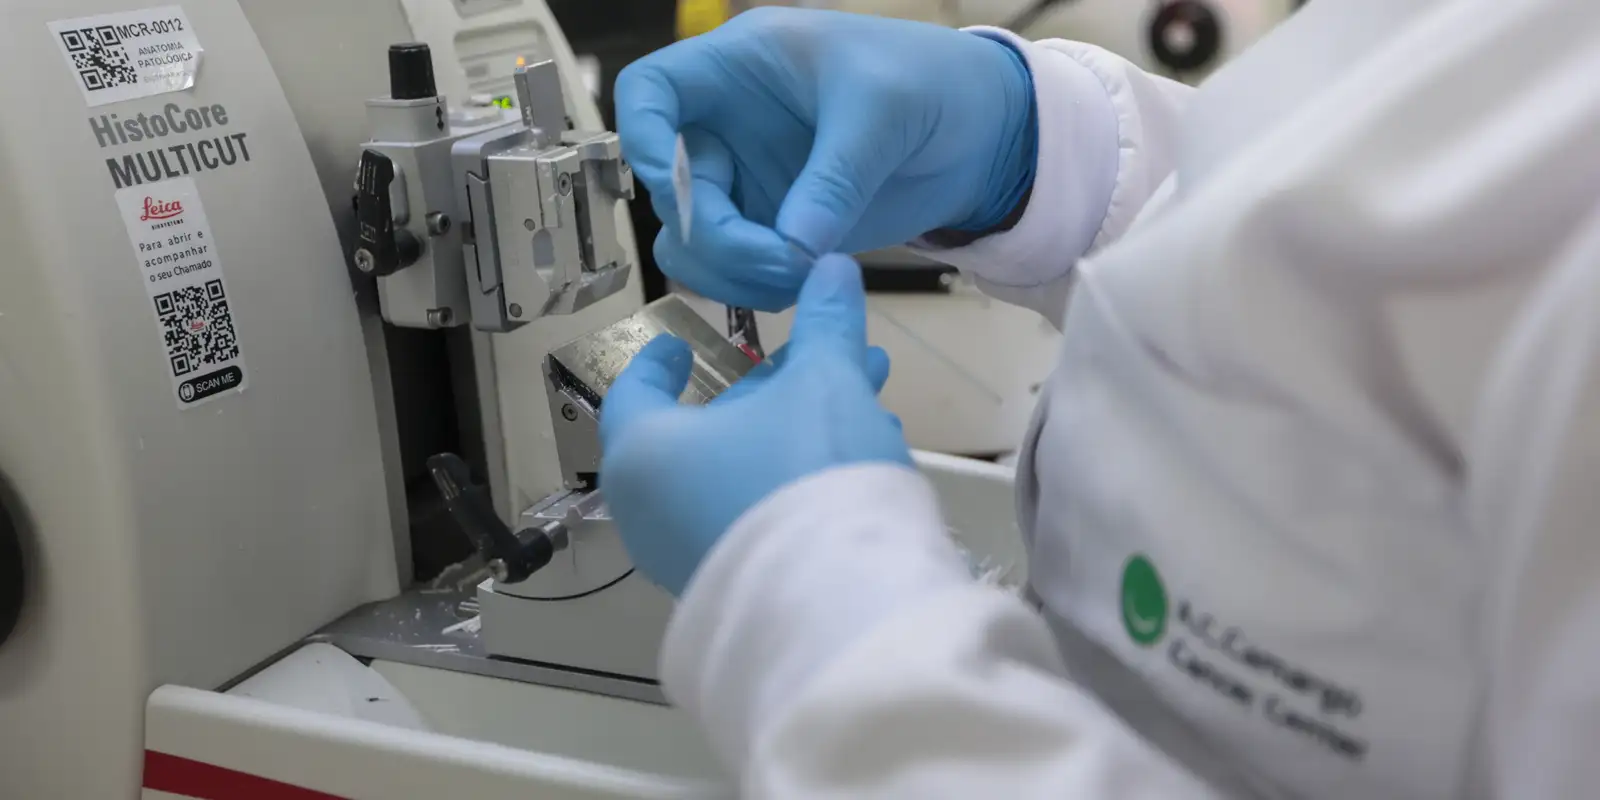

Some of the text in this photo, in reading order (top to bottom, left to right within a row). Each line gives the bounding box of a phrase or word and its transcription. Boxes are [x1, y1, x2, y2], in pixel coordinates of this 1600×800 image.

[117, 18, 184, 41] MCR-0012
[138, 41, 184, 56] ANATOMIA
[138, 52, 193, 68] PATOLÓGICA
[88, 103, 229, 148] HistoCore
[106, 133, 251, 189] MULTICUT
[140, 196, 184, 221] Leica
[139, 230, 203, 252] Para abrir e
[145, 244, 208, 267] acompanhar
[150, 259, 212, 282] o seu Chamado
[196, 371, 236, 393] SCAN ME
